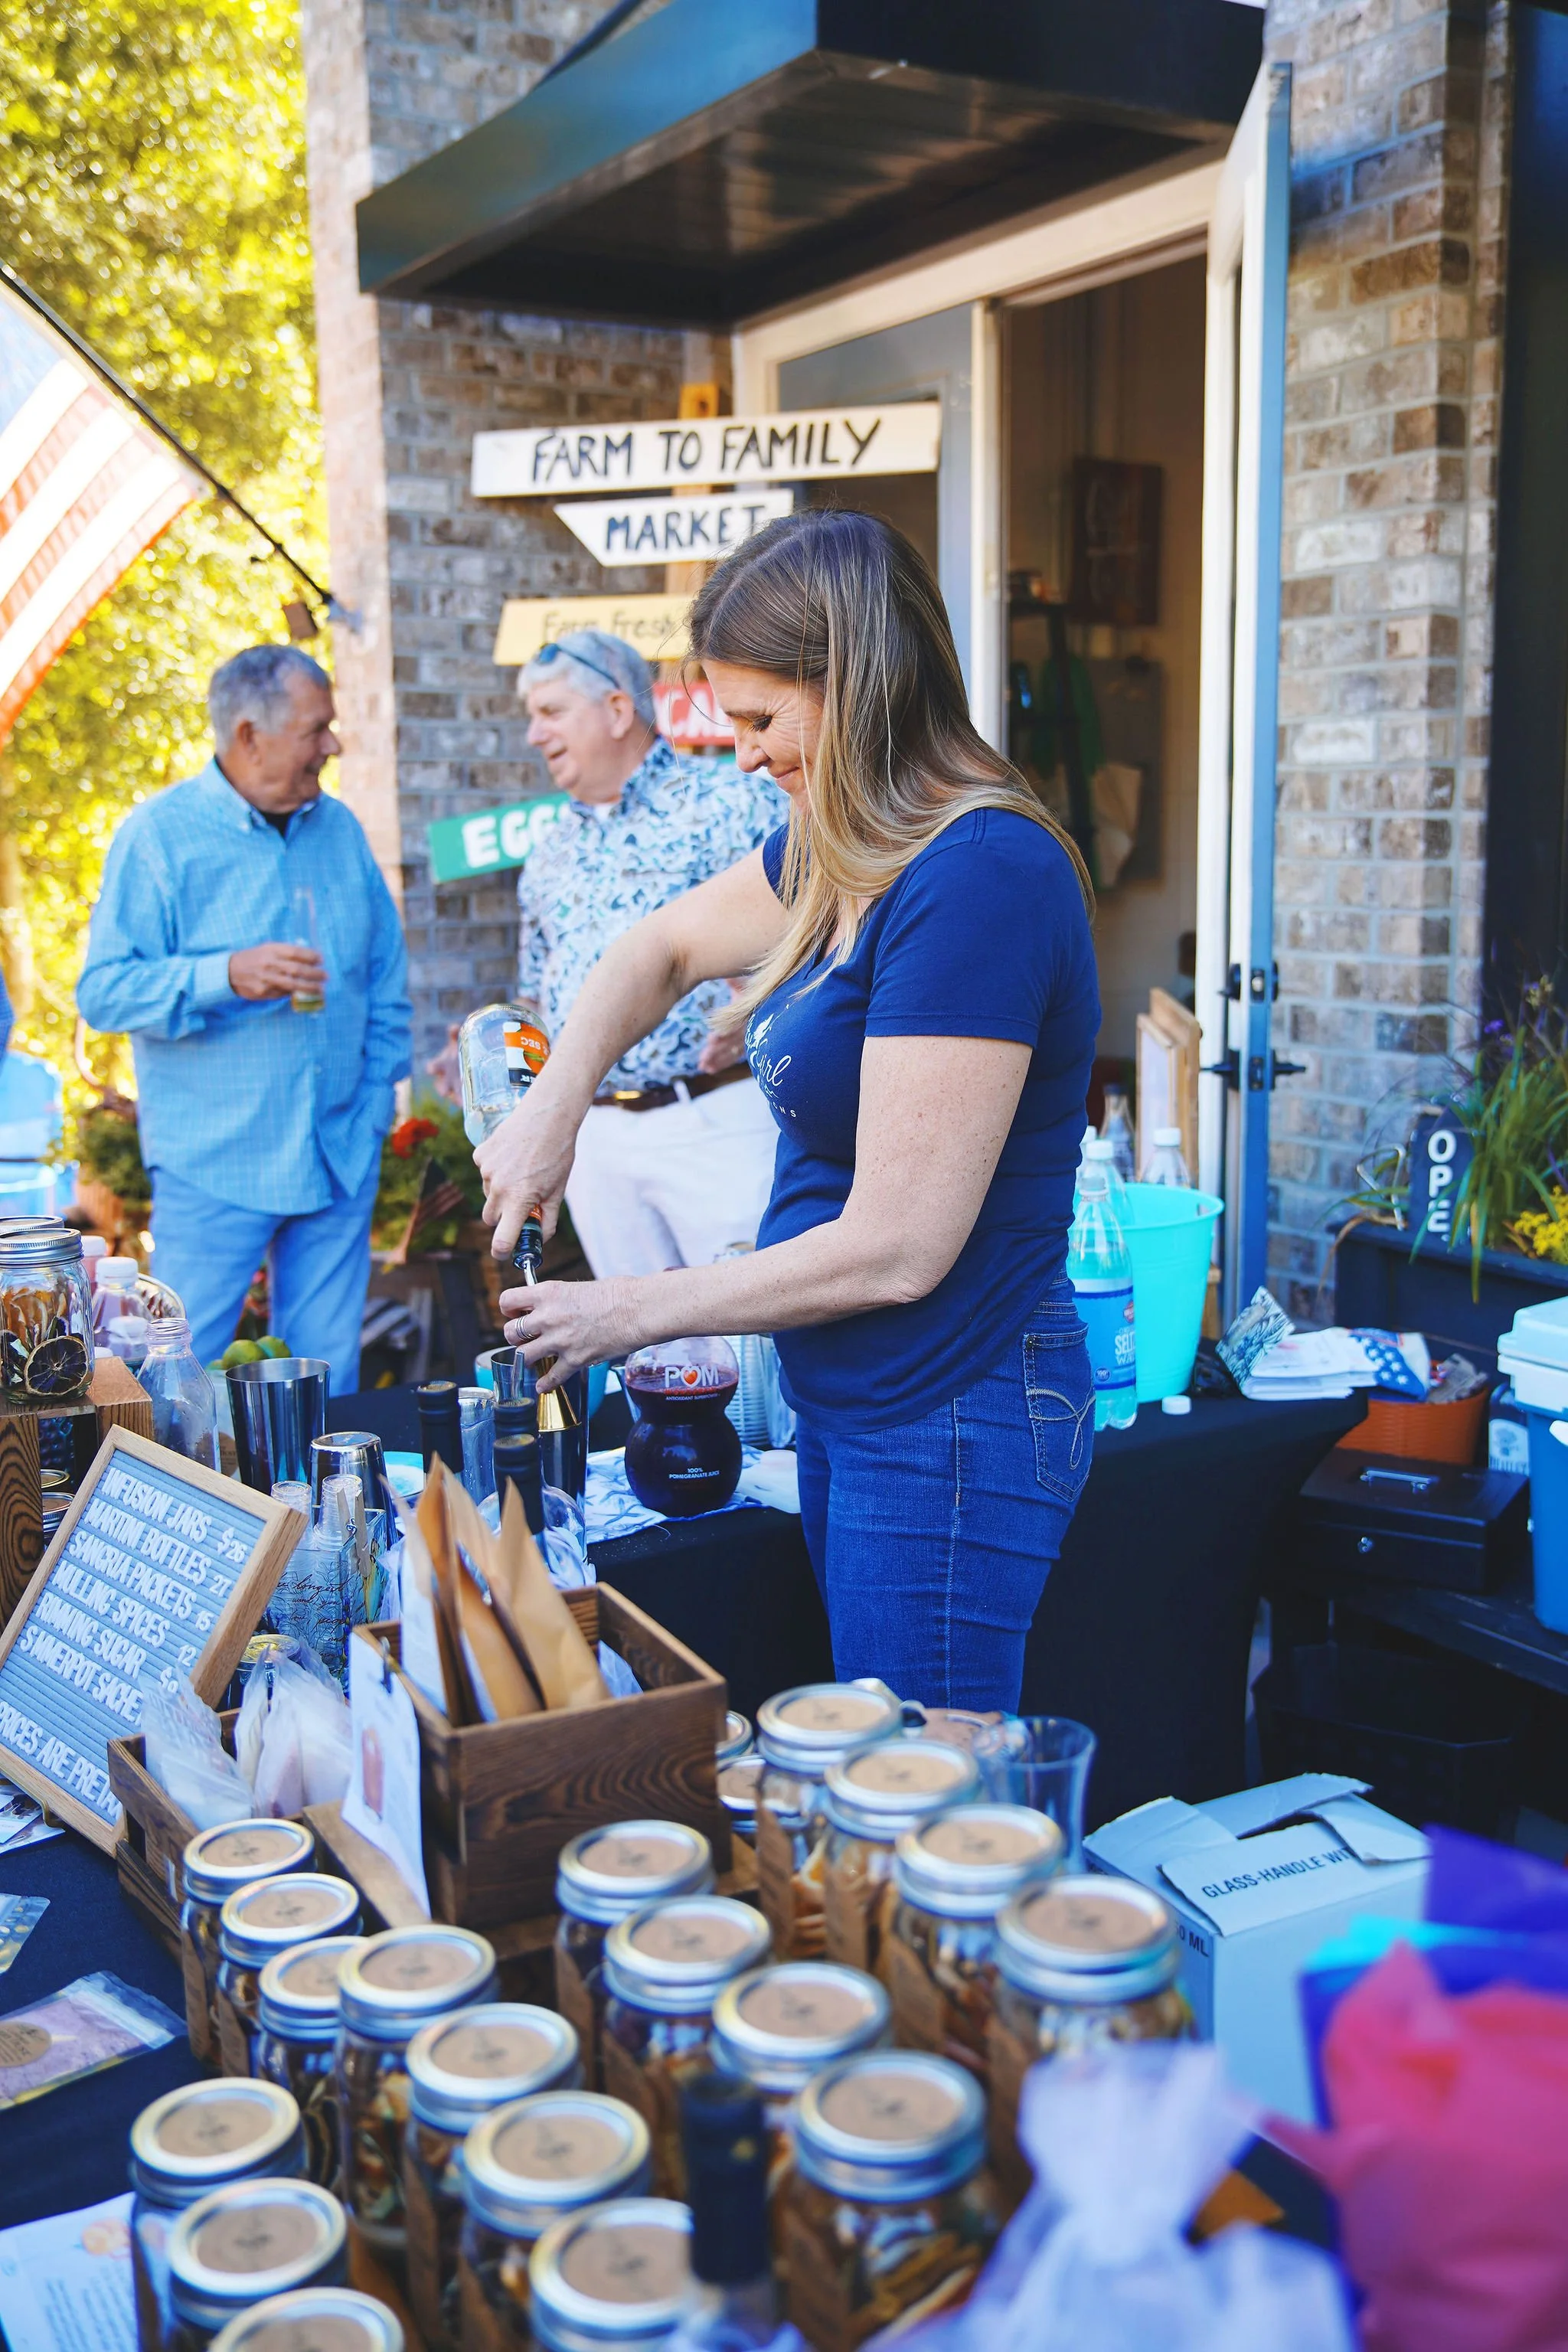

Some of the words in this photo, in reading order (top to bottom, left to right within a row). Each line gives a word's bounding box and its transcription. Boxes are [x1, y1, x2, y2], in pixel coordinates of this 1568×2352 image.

[533, 430, 633, 482] FARM
[658, 430, 703, 472] TO
[721, 417, 882, 472] FAMILY
[606, 504, 766, 550] MARKET
[1427, 1129, 1457, 1242] OPE
[665, 1365, 719, 1388] POM
[102, 1467, 174, 1523] INFUSION
[167, 1503, 213, 1544] JARS
[217, 1527, 248, 1563] $26
[84, 1498, 147, 1550] MARTINI
[140, 1527, 212, 1586] BOTTLES
[209, 1574, 232, 1598] 27
[69, 1530, 133, 1585] SANGRIA
[126, 1561, 197, 1620] PACKETS
[195, 1610, 215, 1632] 15
[35, 1591, 100, 1648] RIMMING
[93, 1628, 148, 1679] SUGAR
[53, 1560, 116, 1617] MULLING
[112, 1596, 170, 1648] SPICES
[178, 1644, 198, 1668] 12
[92, 1671, 144, 1726] SACHE
[36, 1736, 77, 1779] ARE
[1201, 1855, 1326, 1899] GLASS-HANDLE
[1189, 1931, 1210, 1958] ML
